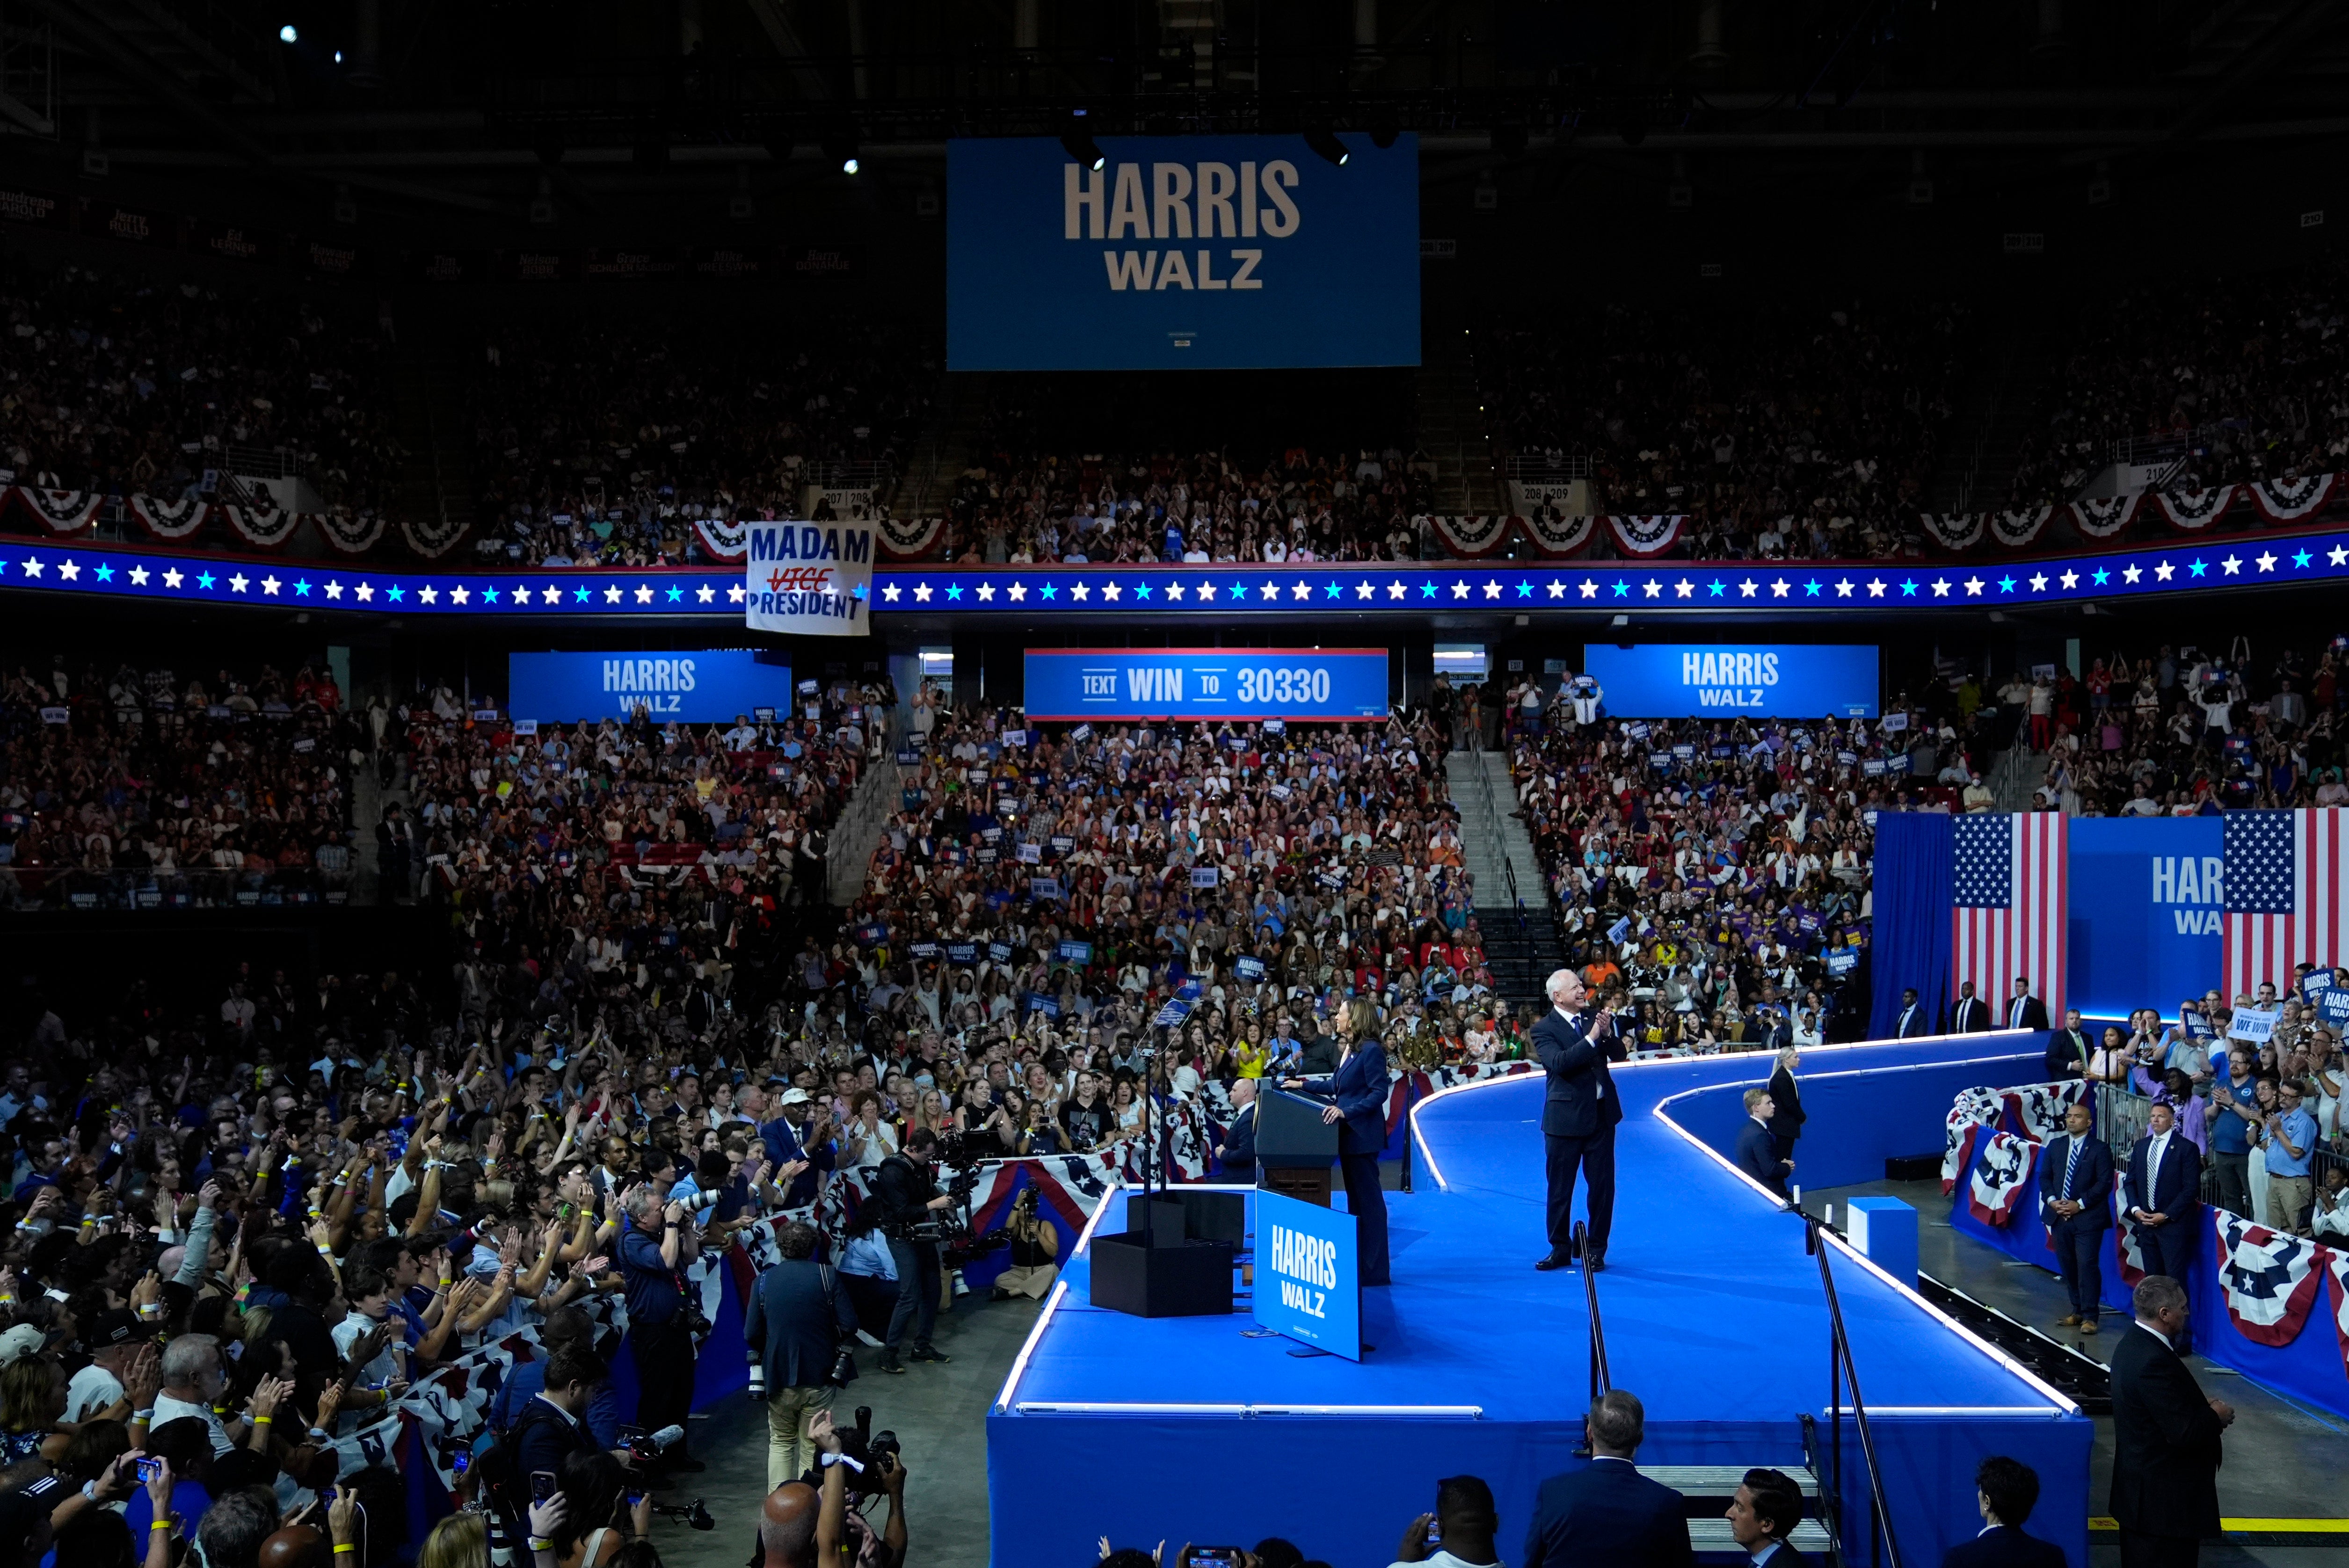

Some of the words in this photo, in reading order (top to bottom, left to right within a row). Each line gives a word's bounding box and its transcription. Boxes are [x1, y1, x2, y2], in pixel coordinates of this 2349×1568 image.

[0, 191, 55, 210] audrena
[1063, 160, 1300, 239] HARRIS
[2304, 214, 2321, 225] 210
[1439, 242, 1454, 252] 209
[434, 254, 457, 266] Tim
[519, 253, 560, 265] Nelson
[617, 252, 650, 263] Grace
[713, 250, 744, 262] Mike
[807, 249, 841, 261] Harry
[427, 266, 464, 276] PERRY
[589, 263, 634, 273] SCHULER
[697, 261, 759, 271] VREESWYK
[796, 261, 850, 270] DONAHUE
[1104, 249, 1263, 290] WALZ
[2147, 468, 2165, 480] 210
[826, 493, 841, 503] 207
[1526, 488, 1541, 499] 208
[1551, 488, 1568, 499] 209
[751, 525, 869, 563] MADAM
[767, 567, 834, 592] VICE
[749, 592, 862, 620] PRESIDENT
[603, 659, 695, 691] HARRIS
[1683, 653, 1779, 685] HARRIS
[799, 681, 817, 690] HARRIS
[1083, 676, 1116, 694] TEXT
[1128, 668, 1182, 702] WIN
[1201, 676, 1219, 694] TO
[1237, 668, 1330, 703] 30330
[619, 695, 681, 712] WALZ
[1700, 689, 1763, 707] WALZ
[1630, 725, 1648, 736] HARRIS
[1839, 752, 1857, 762] HARRIS
[1888, 755, 1907, 768] HARRIS
[1864, 761, 1885, 769] HARRIS
[969, 770, 988, 778] HARRIS
[1271, 784, 1289, 795] HARRIS
[998, 799, 1018, 808] HARRIS
[982, 828, 1002, 837] HARRIS
[1052, 837, 1073, 846] HARRIS
[976, 849, 996, 857] HARRIS
[1321, 873, 1342, 887] HARRIS
[2153, 857, 2224, 904] HAR
[72, 893, 97, 903] HARRIS
[138, 893, 161, 901] HARRIS
[237, 892, 259, 900] HARRIS
[2175, 910, 2223, 934] WA
[1613, 931, 1621, 942] WE
[911, 943, 937, 952] HARRIS
[948, 945, 975, 954] HARRIS
[989, 943, 1011, 957] HARRIS
[1061, 947, 1070, 956] WE
[1072, 949, 1086, 958] WIN
[990, 952, 1006, 962] WALZ
[1830, 955, 1855, 967] HARRIS
[1239, 958, 1265, 972] HARRIS
[1242, 969, 1259, 977] WALZ
[2305, 973, 2330, 991] HARRIS
[2325, 992, 2349, 1009] HAR
[1032, 1000, 1042, 1010] WE
[1043, 1002, 1057, 1015] WIN
[2188, 1013, 2204, 1026] HAR
[2237, 1018, 2251, 1032] WE
[2252, 1021, 2270, 1034] WIN
[1273, 1224, 1336, 1291] HARRIS
[1281, 1280, 1325, 1319] WALZ
